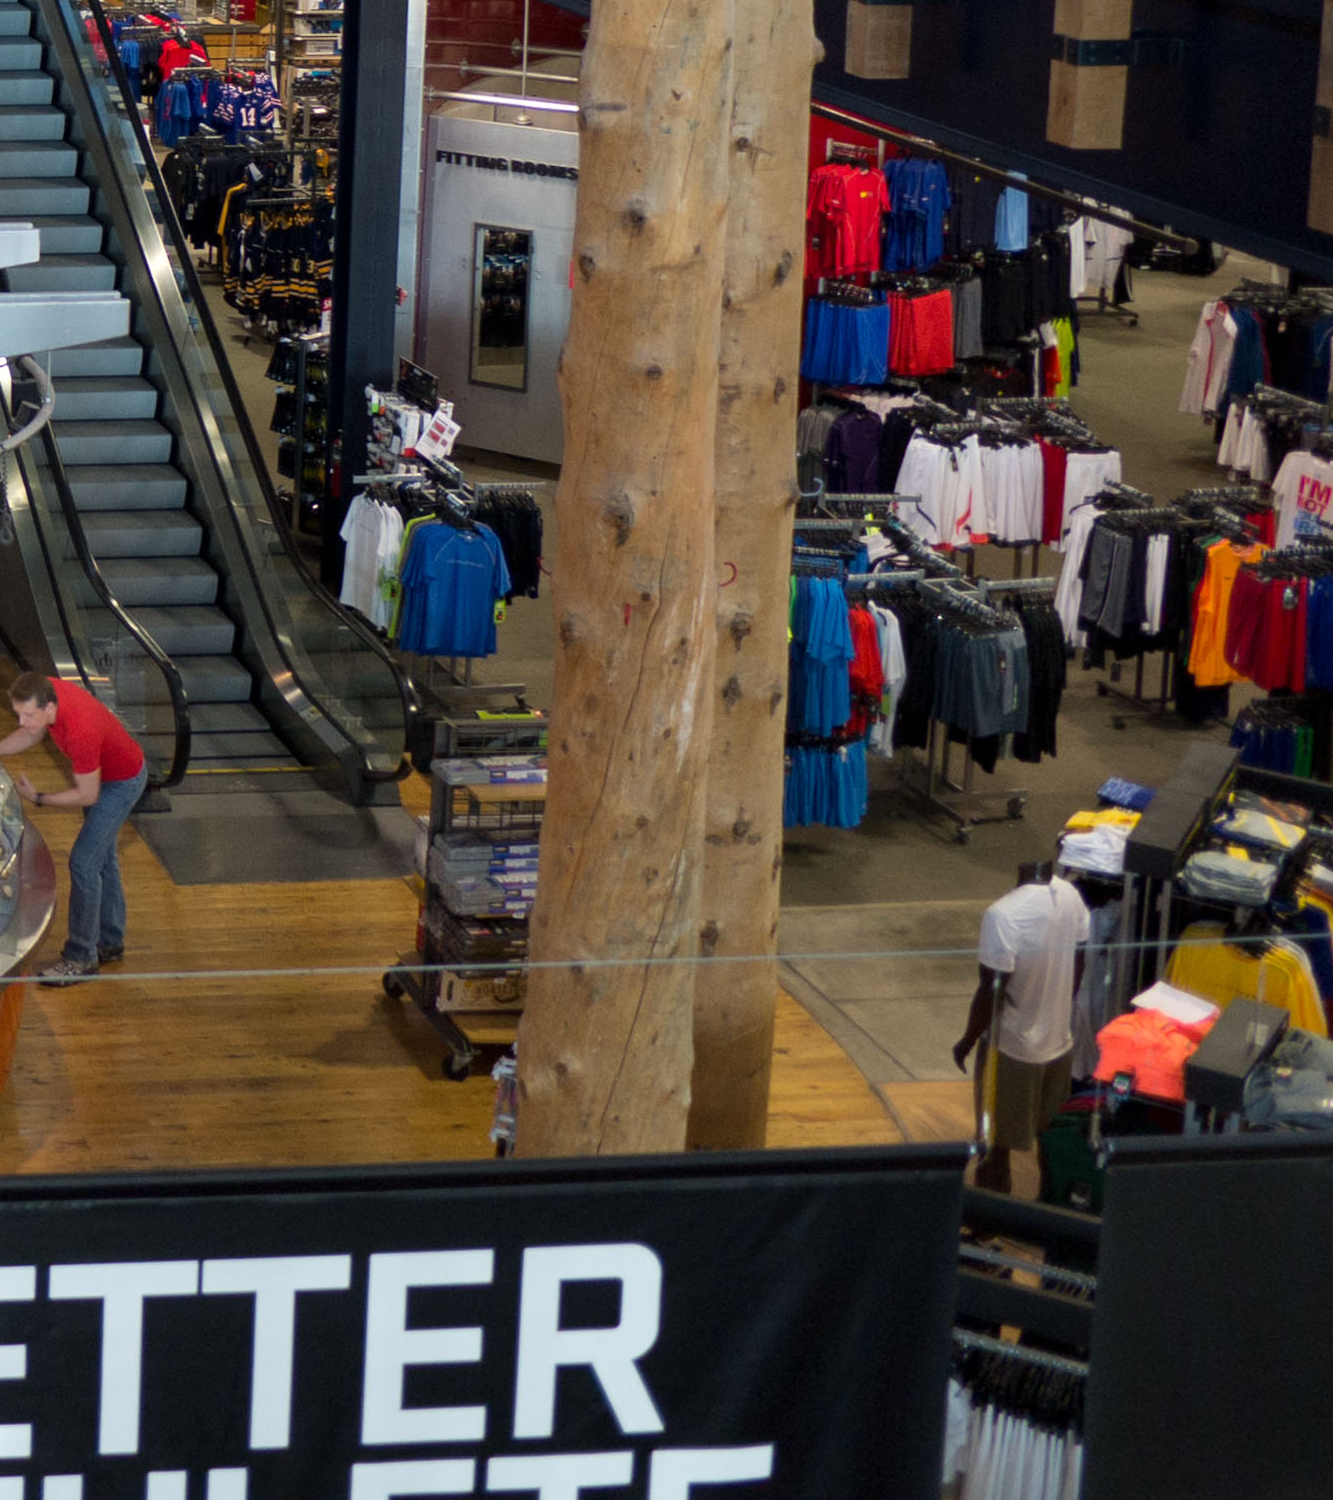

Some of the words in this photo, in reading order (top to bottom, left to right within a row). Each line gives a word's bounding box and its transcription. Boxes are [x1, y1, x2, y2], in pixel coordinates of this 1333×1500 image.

[240, 107, 256, 126] 14
[436, 150, 509, 171] FITTING
[511, 160, 579, 181] ROOMS
[1299, 474, 1332, 506] I'M
